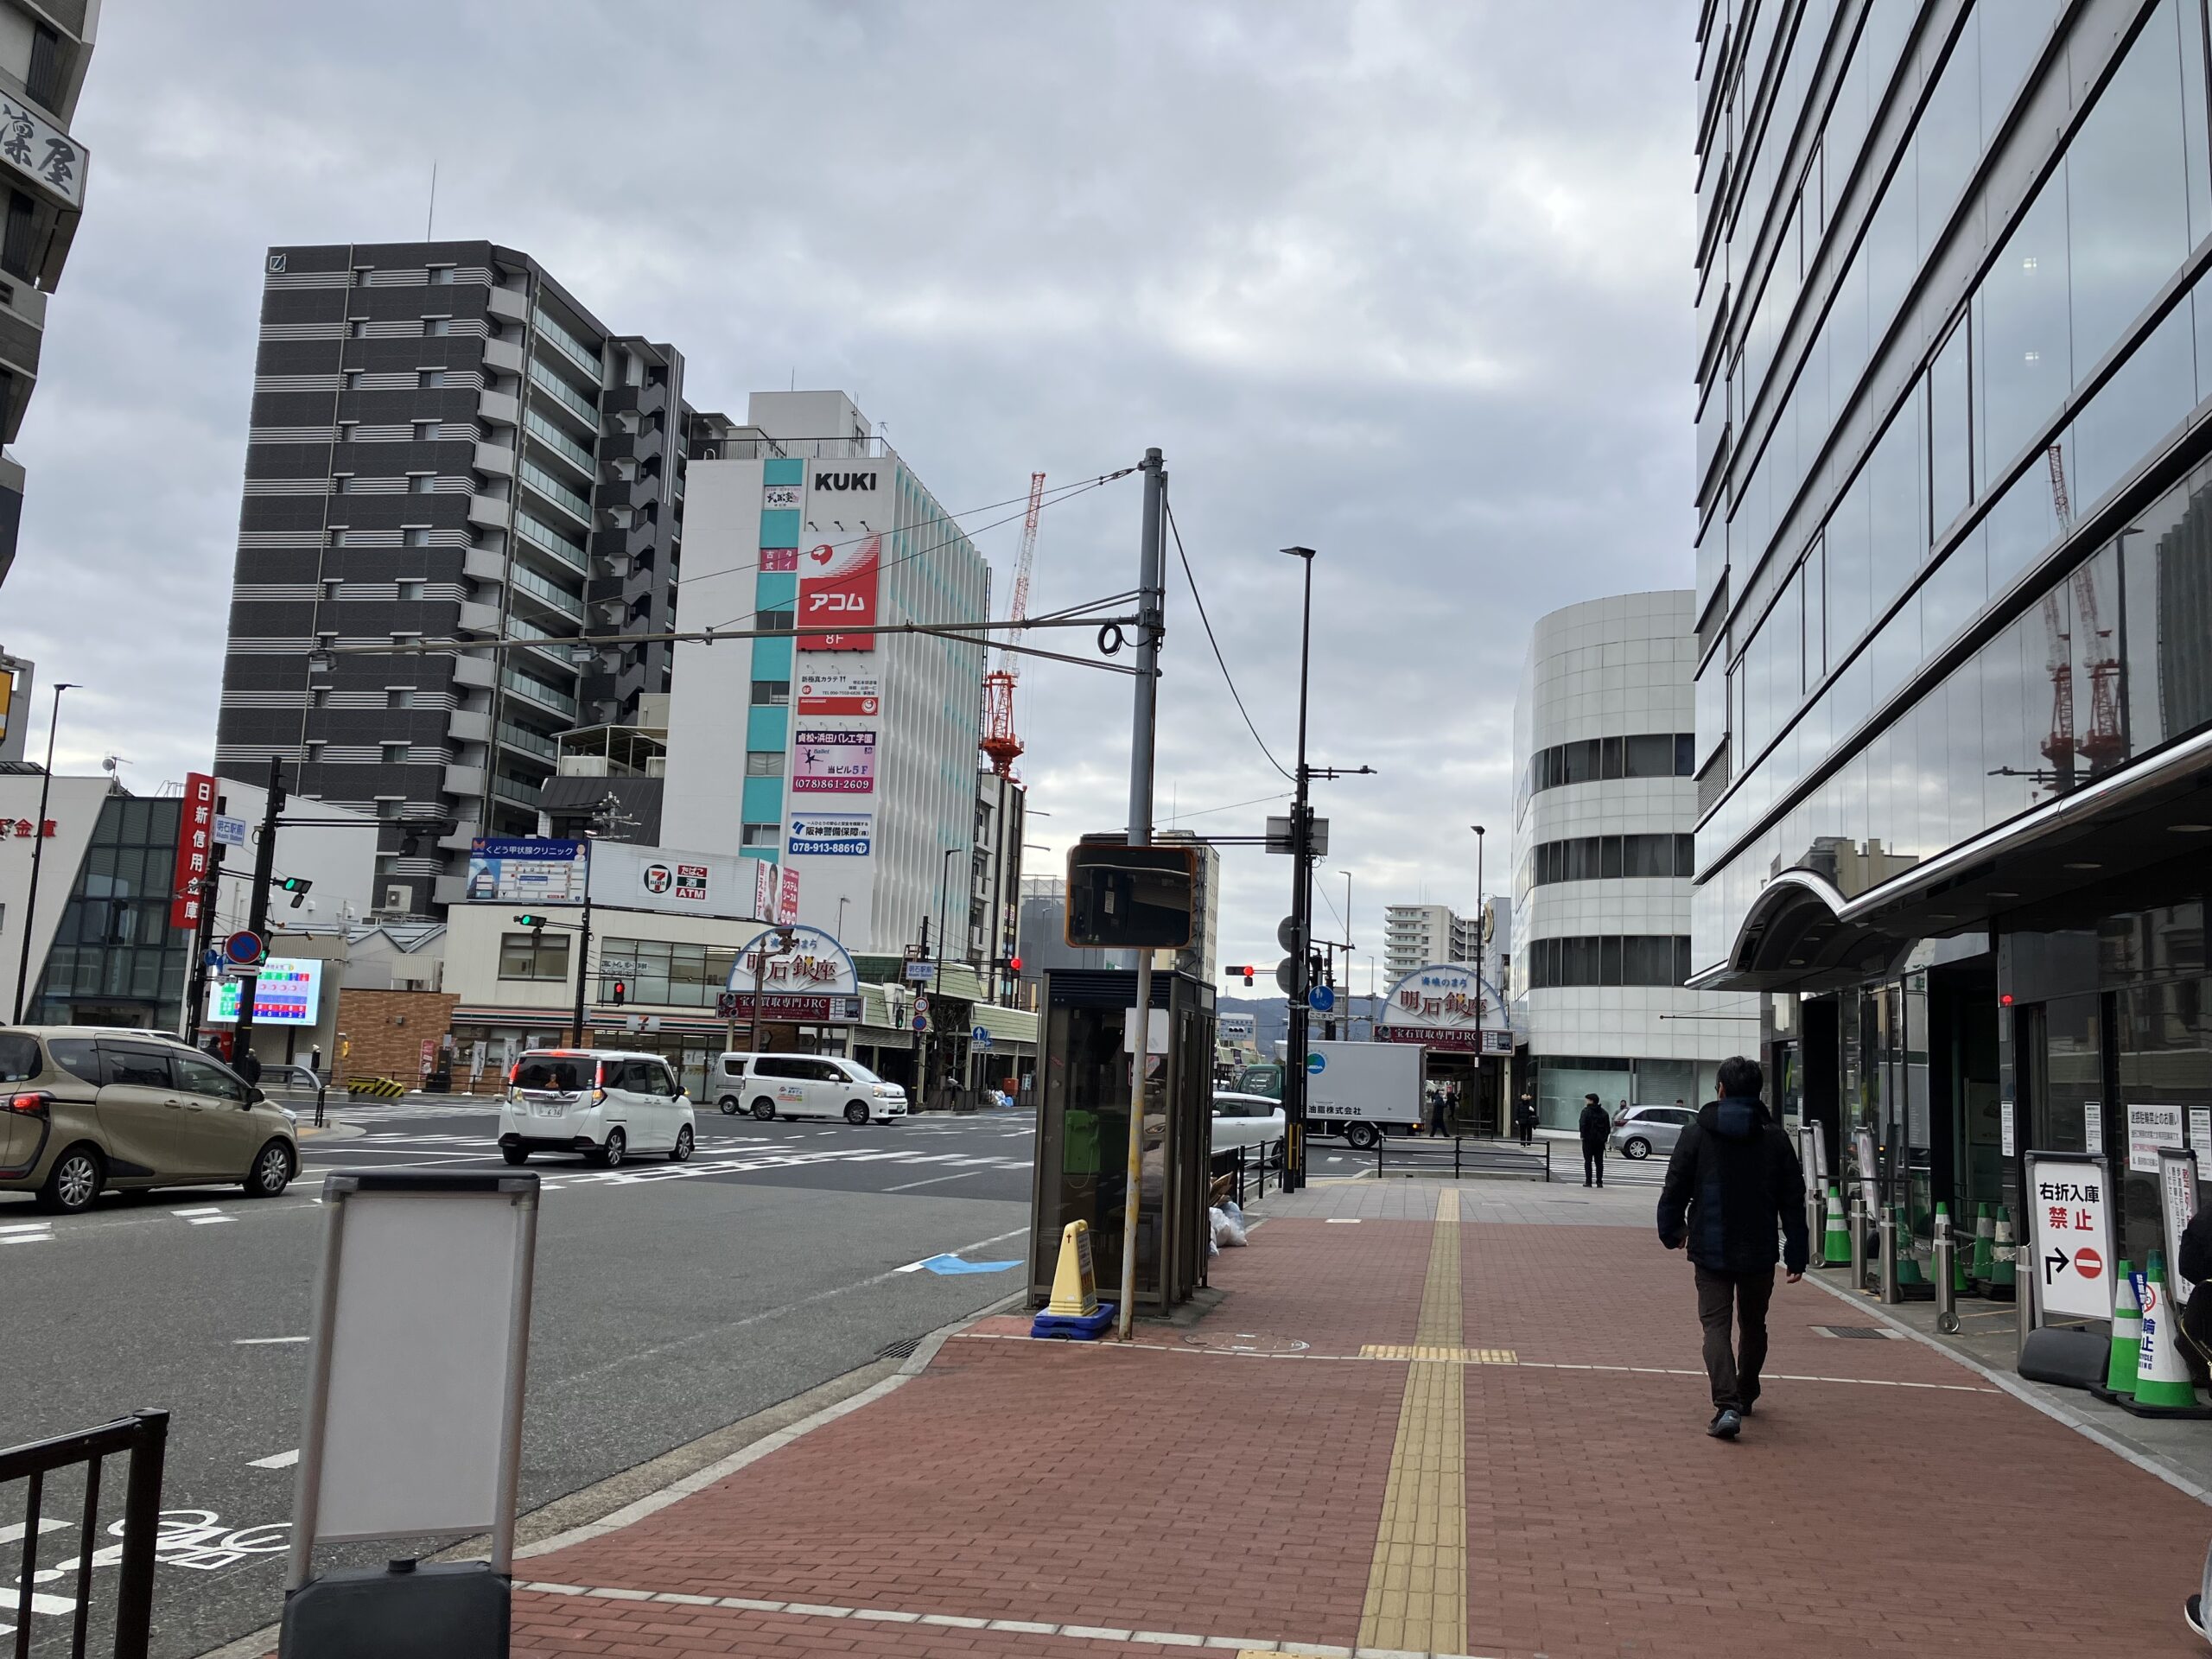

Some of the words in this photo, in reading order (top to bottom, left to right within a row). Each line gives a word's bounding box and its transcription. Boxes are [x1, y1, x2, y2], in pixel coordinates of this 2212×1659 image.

[815, 473, 877, 491] KUKI
[810, 594, 865, 612] アコム
[798, 733, 873, 743] 貞松・浜田バレエ学園
[796, 779, 869, 789] (078)861-2609
[184, 782, 210, 919] 日新信用金庫
[486, 845, 573, 855] くどう甲状腺クリニック
[792, 842, 855, 853] 078-913-8861
[681, 866, 704, 876] たばこ
[685, 877, 697, 887] 酒
[678, 888, 704, 899] ATM
[803, 999, 827, 1008] JRC
[1401, 989, 1488, 1017] 明石銀座
[1395, 1028, 1455, 1040] 宝石買取専門
[2039, 1182, 2101, 1204] 右折入庫
[2049, 1206, 2094, 1231] 禁止
